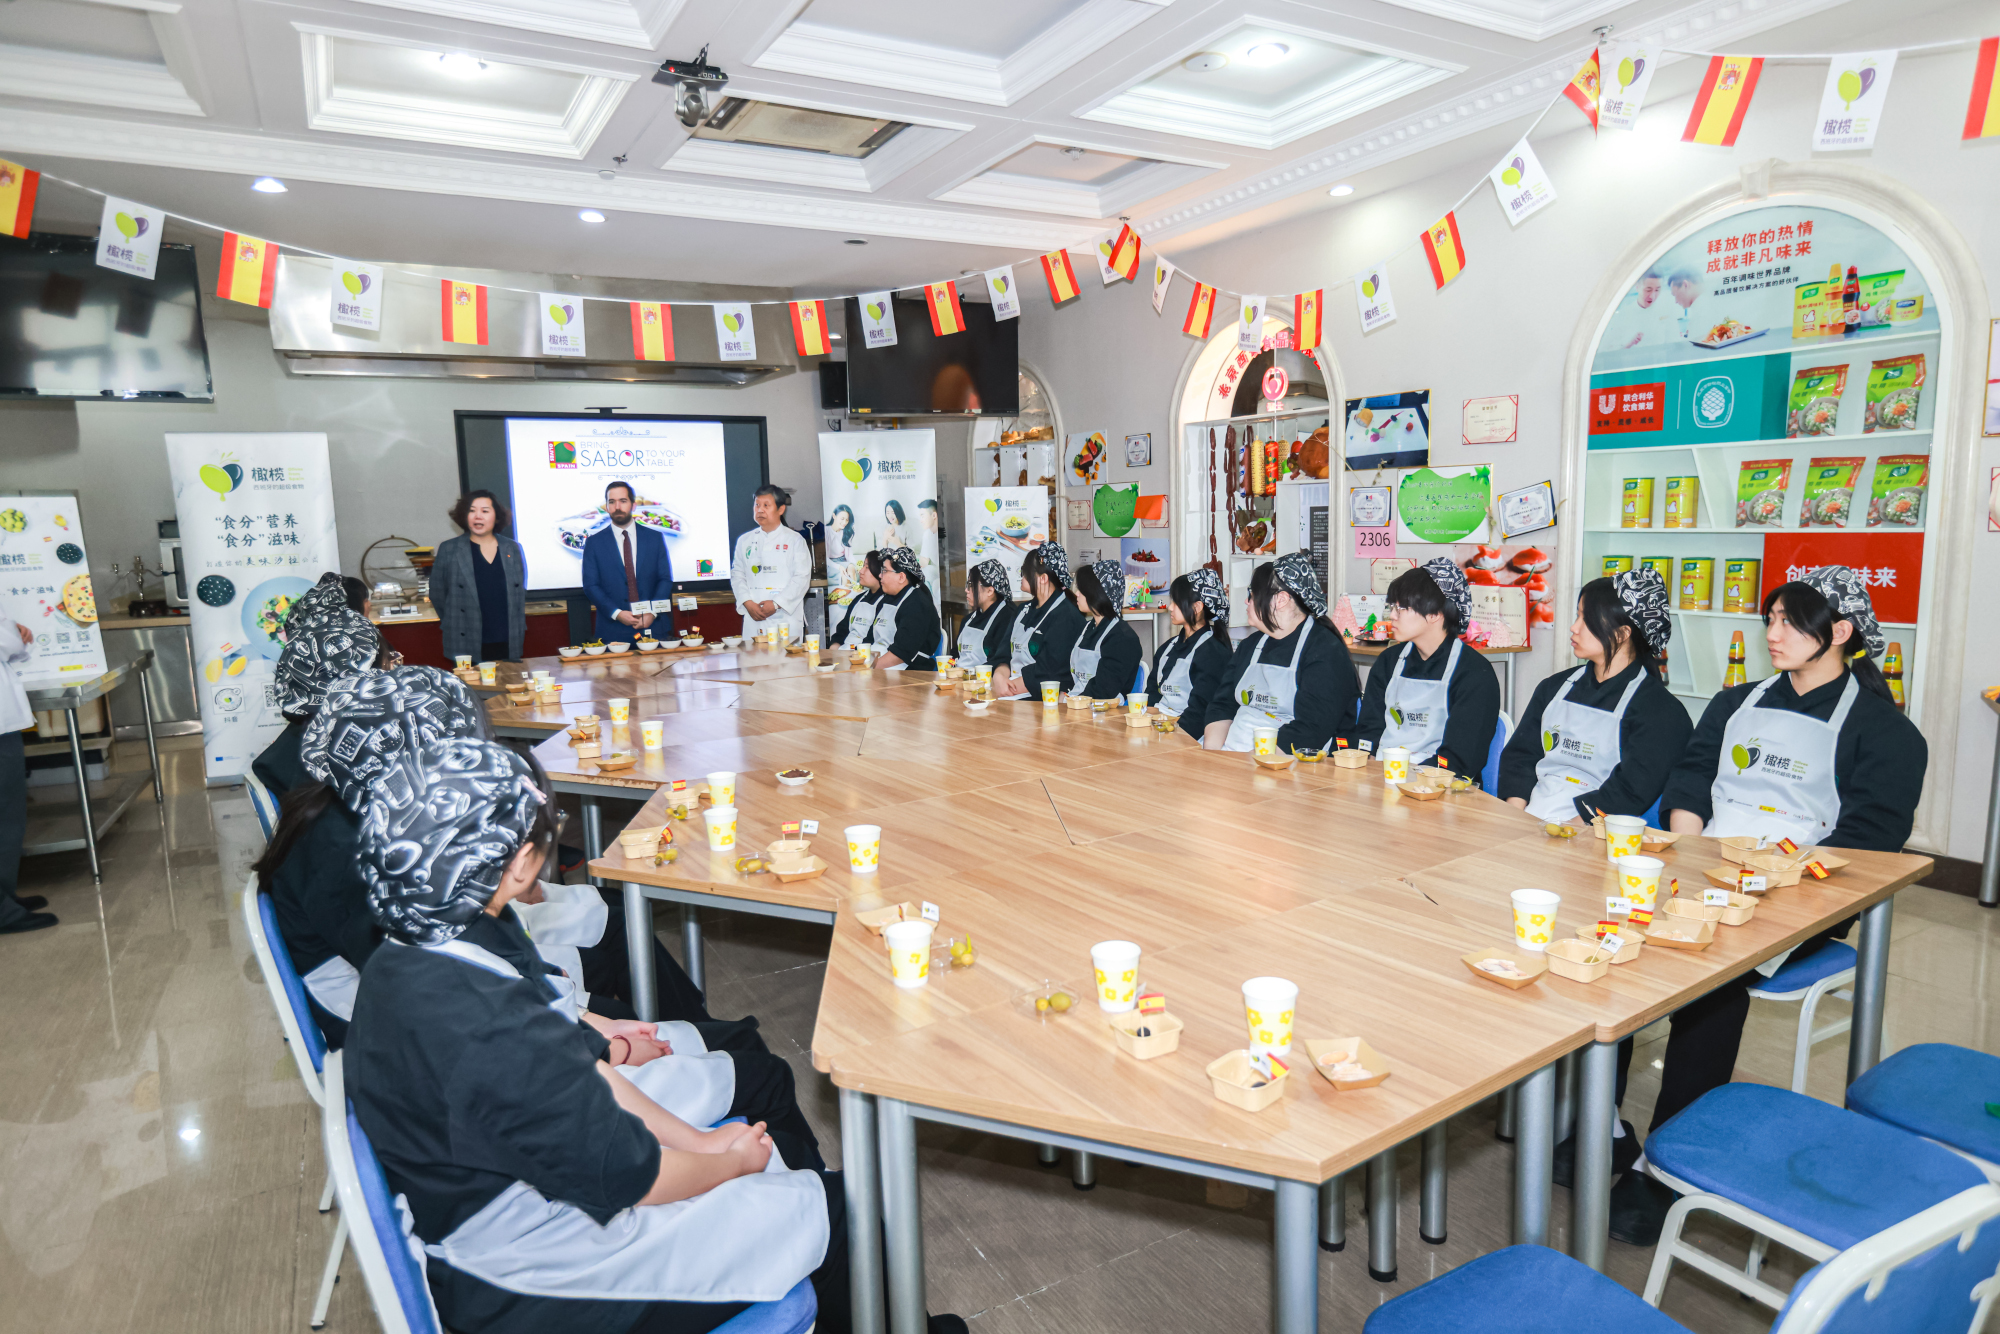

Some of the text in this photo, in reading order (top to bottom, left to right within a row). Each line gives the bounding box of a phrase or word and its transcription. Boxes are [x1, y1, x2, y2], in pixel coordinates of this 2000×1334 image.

[1604, 98, 1624, 114] 橄榄
[1822, 118, 1852, 135] 橄榄
[1510, 190, 1533, 211] 橄榄
[1707, 220, 1813, 255] 释放你的热情
[107, 244, 134, 261] 橄榄
[1706, 240, 1812, 274] 成就非凡味来
[1722, 266, 1791, 285] 百年调味世界品牌
[1714, 277, 1799, 296] 高品质餐饮解决方案的好伙伴
[338, 302, 360, 316] 橄榄
[549, 334, 568, 345] 橄榄
[1623, 392, 1654, 402] 联合利华
[1623, 402, 1654, 412] 饮食策划
[580, 450, 645, 467] SABOR
[878, 460, 902, 473] 橄榄
[251, 467, 285, 482] 橄榄
[215, 513, 299, 530] “食分”营养
[218, 531, 301, 548] “食分”滋味
[1360, 532, 1391, 546] 2306
[1562, 738, 1581, 751] 橄榄
[1764, 754, 1791, 770] 橄榄
[1761, 767, 1803, 781] 西班牙的超级食物
